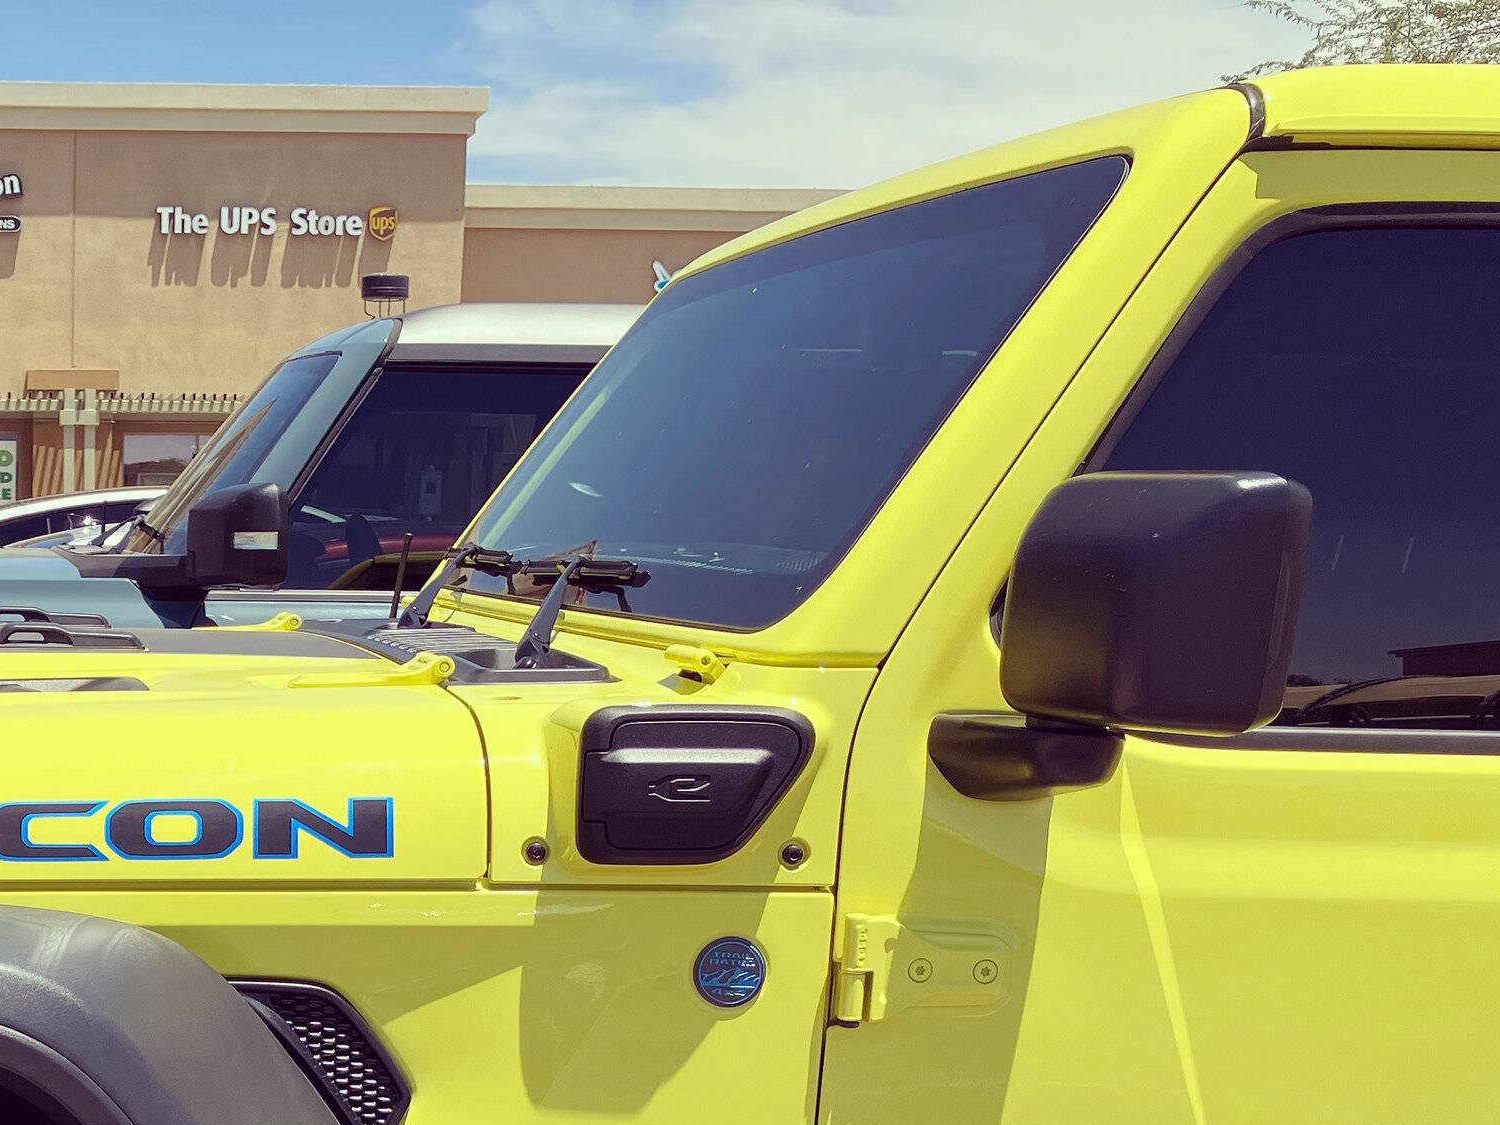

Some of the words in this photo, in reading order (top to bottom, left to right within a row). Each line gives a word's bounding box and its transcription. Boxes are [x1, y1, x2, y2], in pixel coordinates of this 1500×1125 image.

[156, 206, 209, 235] The
[220, 206, 277, 235] UPS
[290, 207, 363, 236] Store
[372, 217, 395, 236] ups
